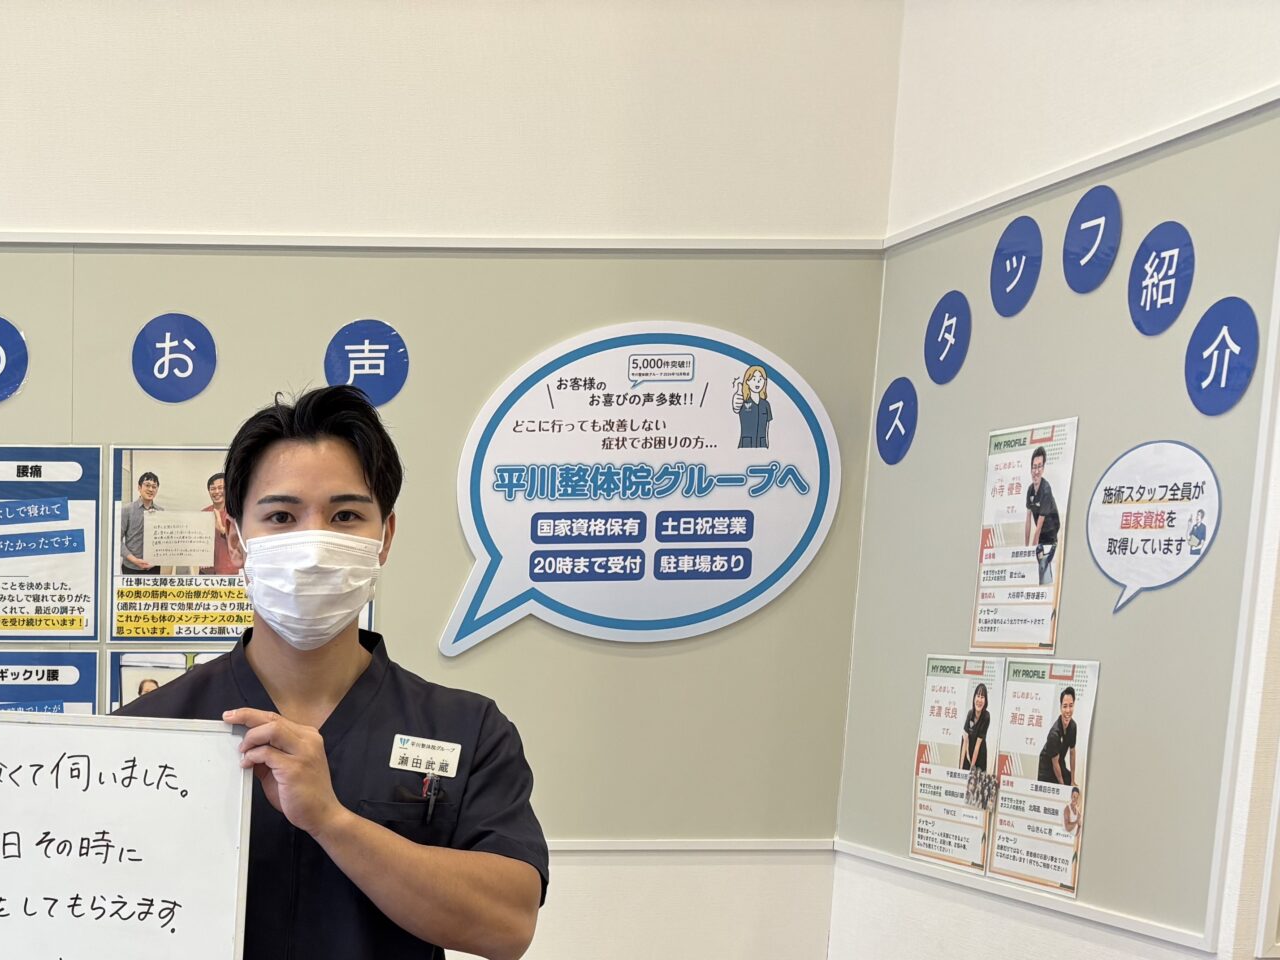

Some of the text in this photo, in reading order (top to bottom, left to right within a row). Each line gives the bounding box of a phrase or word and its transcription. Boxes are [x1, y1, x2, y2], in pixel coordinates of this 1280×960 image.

[556, 376, 607, 392] お客様の
[512, 418, 667, 434] どこに行っても改善しない
[1003, 437, 1027, 449] PROFILE
[16, 464, 42, 478] 腰痛
[493, 461, 810, 502] 平川整体院グループへ
[1101, 480, 1207, 505] 施術スタッフ全員が
[537, 517, 748, 537] 国家資格保有 土日祝営業
[1120, 508, 1177, 530] 国家資格を
[1106, 536, 1187, 556] 取得しています
[533, 555, 745, 575] 20時まで受付 駐車場あり
[116, 589, 248, 599] 体の奥の筋肉への治療が効いたと
[940, 665, 961, 675] PROFILE
[1022, 669, 1046, 680] PROFILE
